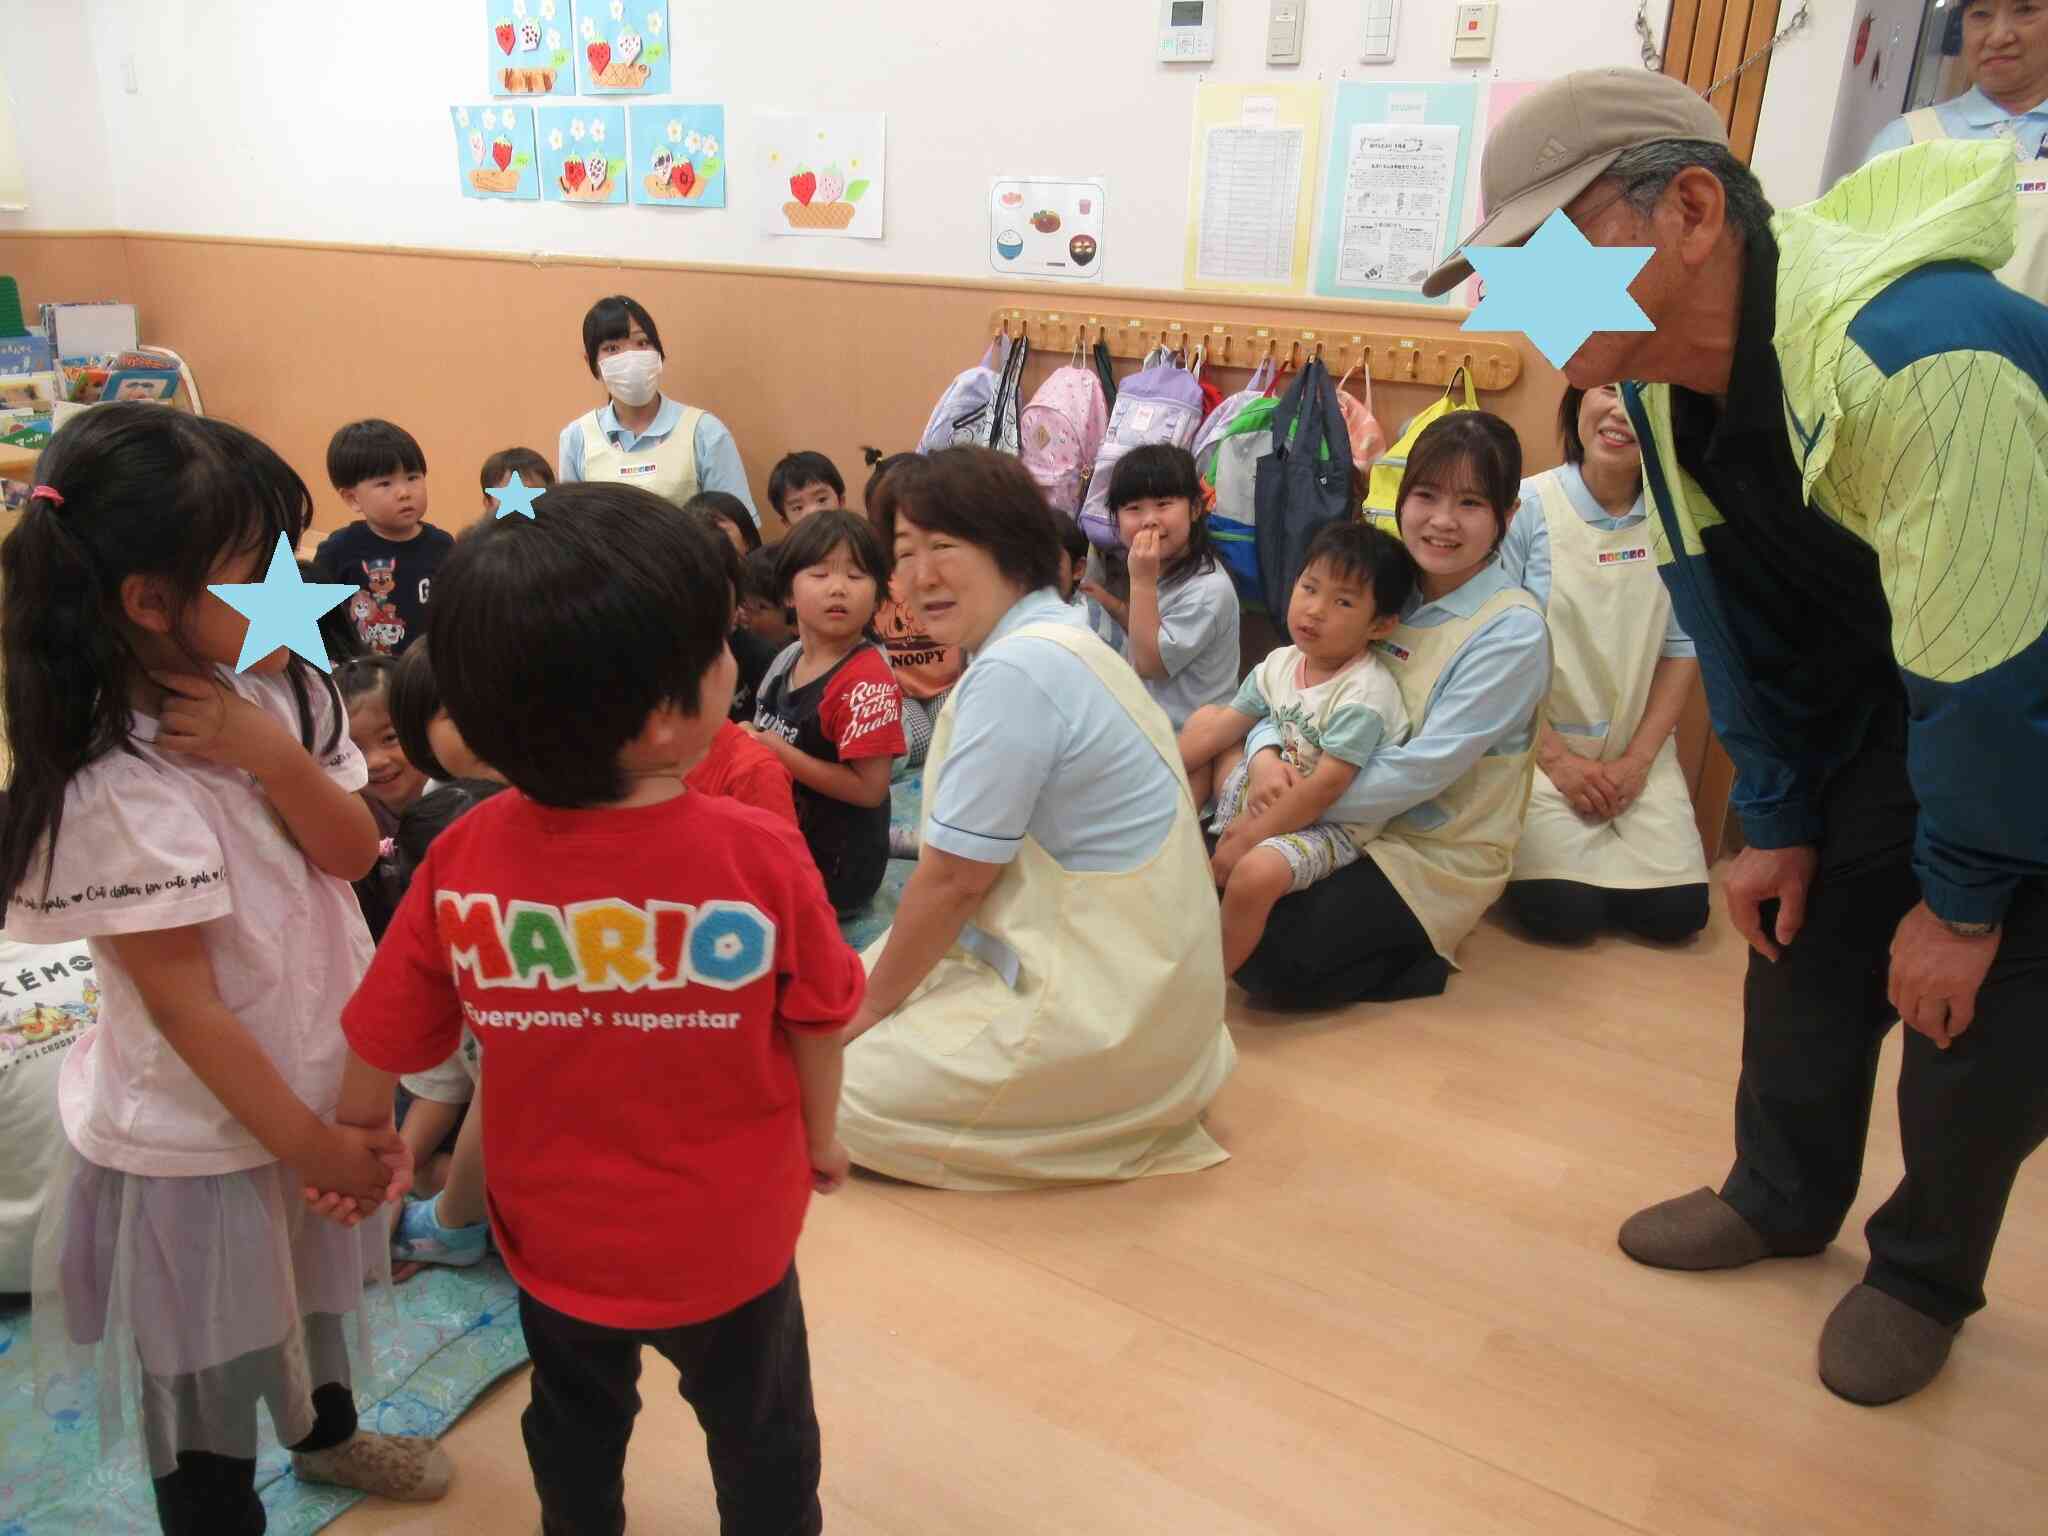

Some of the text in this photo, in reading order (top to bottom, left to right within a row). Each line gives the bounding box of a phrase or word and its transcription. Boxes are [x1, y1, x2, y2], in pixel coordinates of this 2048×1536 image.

[891, 649, 946, 667] NOOPY
[849, 681, 898, 707] Roya
[435, 889, 776, 992] MARIO
[0, 955, 95, 997] KÉMO
[464, 1002, 741, 1032] Everyone's superstar
